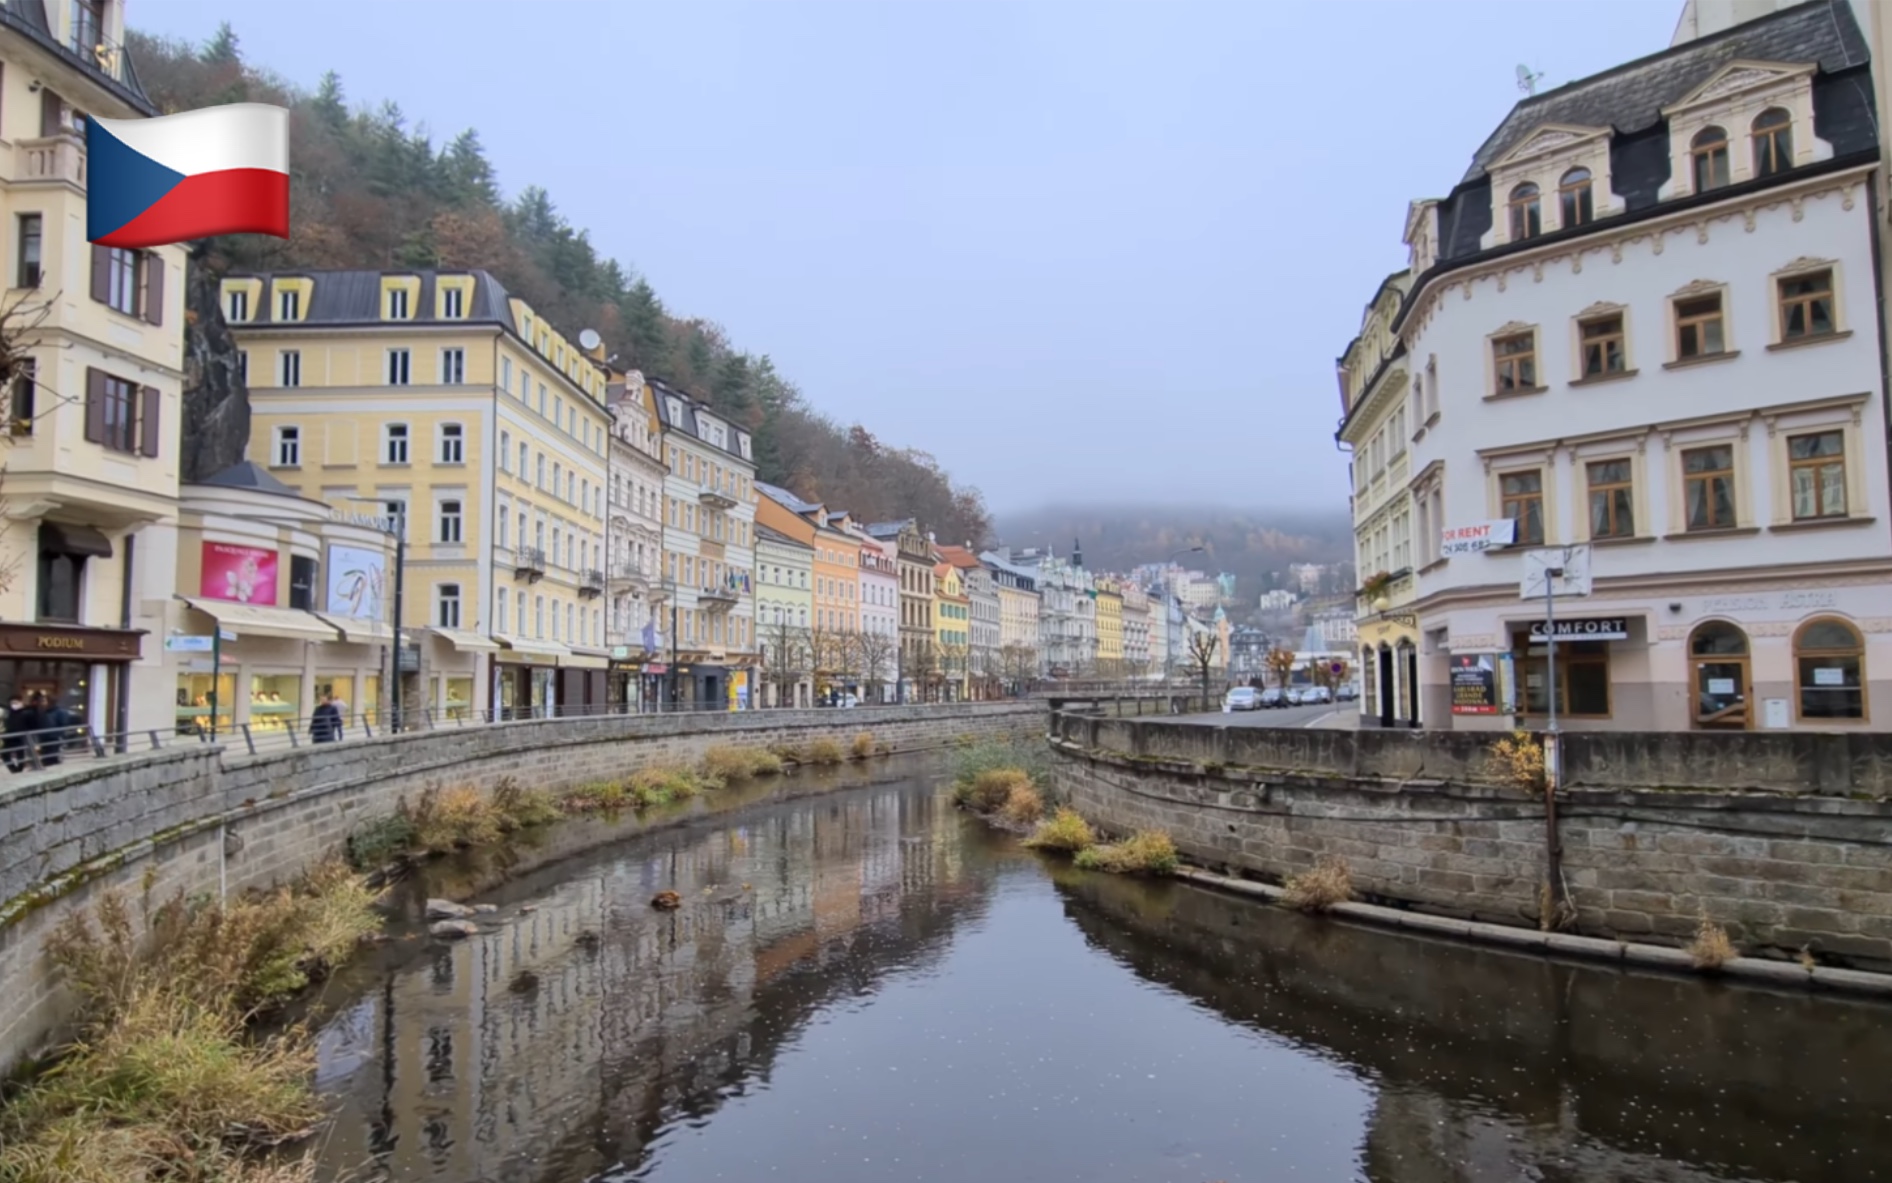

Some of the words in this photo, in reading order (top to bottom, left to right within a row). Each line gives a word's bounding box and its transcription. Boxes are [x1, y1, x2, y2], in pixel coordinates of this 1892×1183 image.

[1458, 525, 1490, 539] RENT
[1530, 620, 1624, 635] COMFORT
[38, 636, 84, 649] PODIUM
